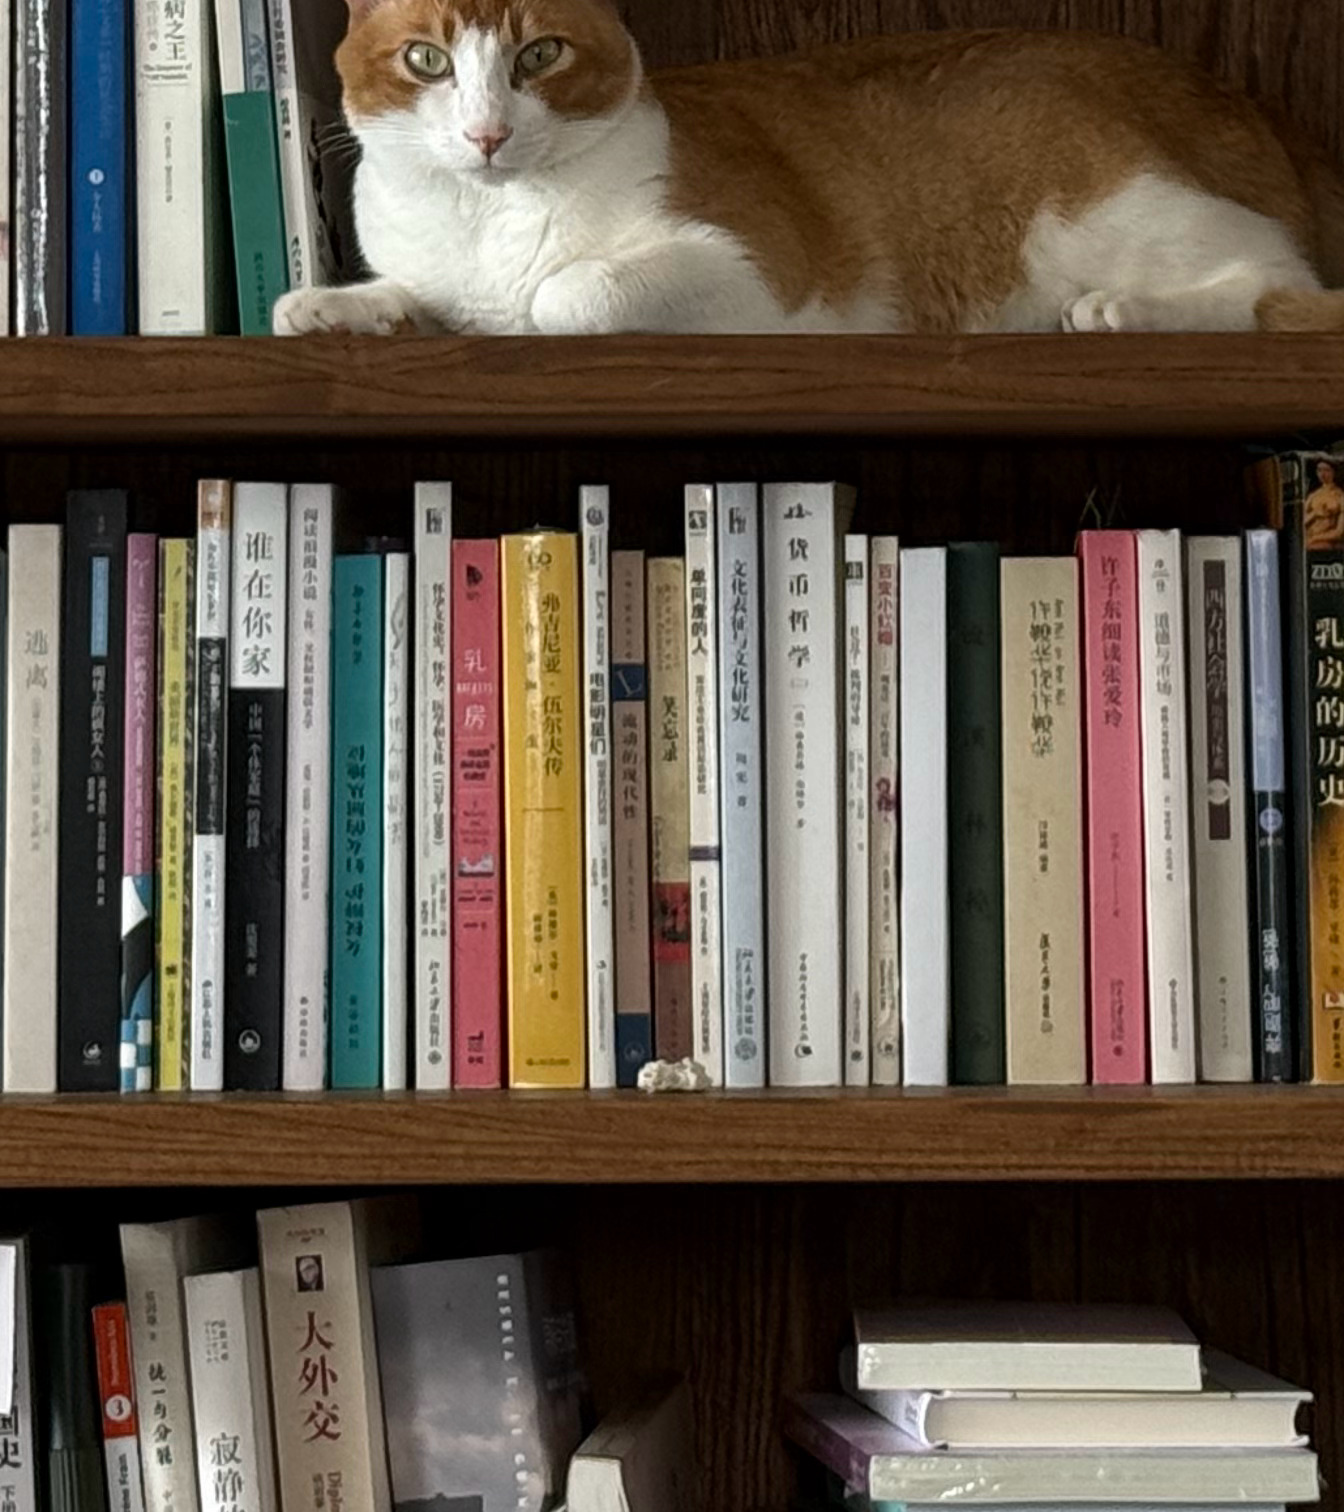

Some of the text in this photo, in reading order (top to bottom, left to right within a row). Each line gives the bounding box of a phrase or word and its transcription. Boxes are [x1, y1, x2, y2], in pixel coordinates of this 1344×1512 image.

[24, 629, 49, 690] 逃离
[241, 531, 274, 677] 谁在你家
[691, 569, 708, 655] 单向度的人
[732, 560, 751, 723] 文化表征与文化研究
[787, 537, 812, 665] 货币哲学
[1100, 555, 1124, 728] 许子东细读张爱玲
[464, 650, 487, 730] 乳 房
[540, 592, 563, 777] 弗吉尼亚·伍尔夫传
[297, 1310, 342, 1443] 大外交
